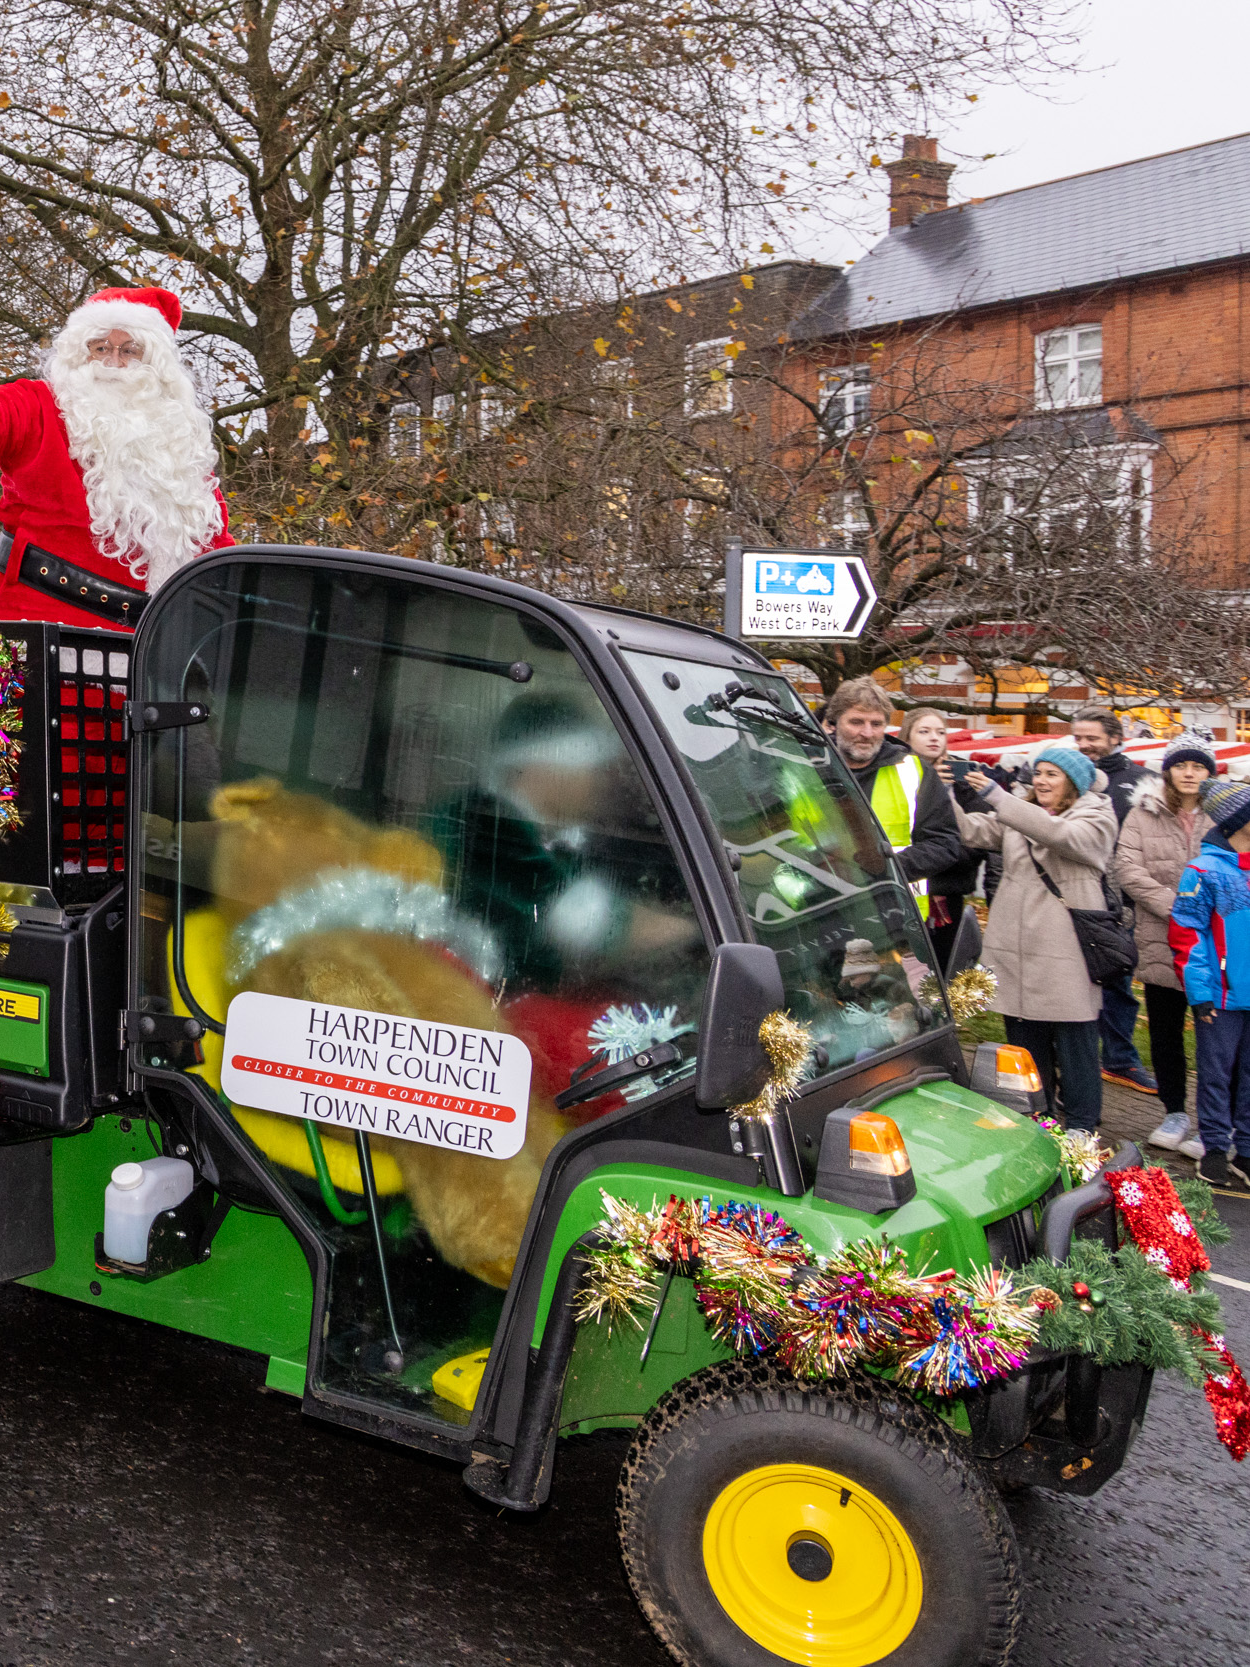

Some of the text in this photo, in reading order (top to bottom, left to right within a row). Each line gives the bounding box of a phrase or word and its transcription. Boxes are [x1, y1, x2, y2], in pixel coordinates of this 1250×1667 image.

[749, 616, 840, 632] West Car Park
[756, 599, 833, 616] Bowers Way
[308, 1007, 503, 1067] HARPENDEN
[244, 1059, 502, 1118] CLOSER TO THE COMMUNITY
[305, 1039, 502, 1095] TOWN COUNCIL
[300, 1091, 495, 1153] TOWN RANGER
